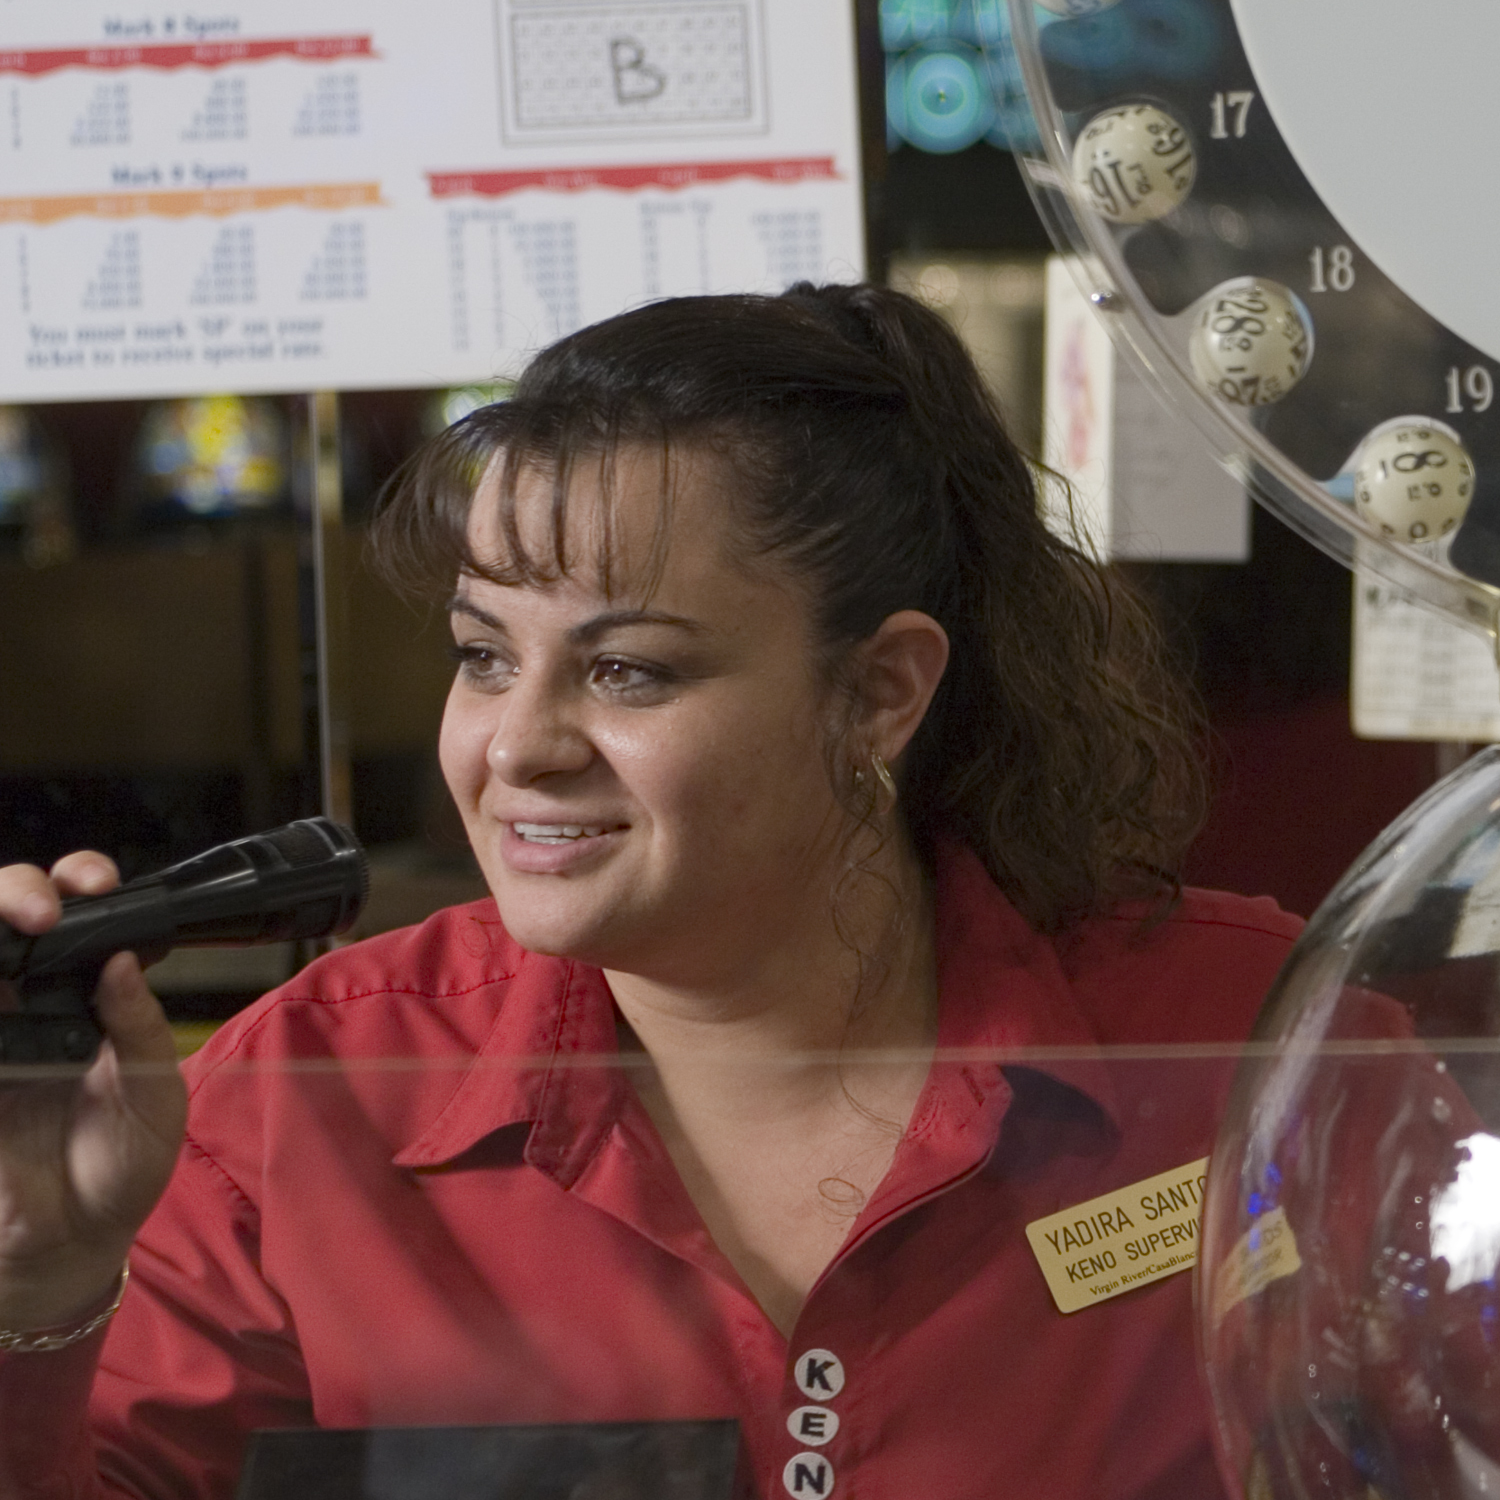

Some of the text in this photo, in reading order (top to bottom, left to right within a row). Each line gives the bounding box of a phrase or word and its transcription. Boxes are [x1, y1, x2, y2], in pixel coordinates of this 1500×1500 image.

[610, 35, 667, 105] B
[1210, 92, 1253, 138] 17
[1309, 247, 1355, 293] 18
[1445, 366, 1493, 412] 19
[1044, 1206, 1135, 1255] YADIRA
[1066, 1216, 1201, 1283] KENO SUPERVI
[1090, 1250, 1197, 1296] Virgin River/CasaBlanc
